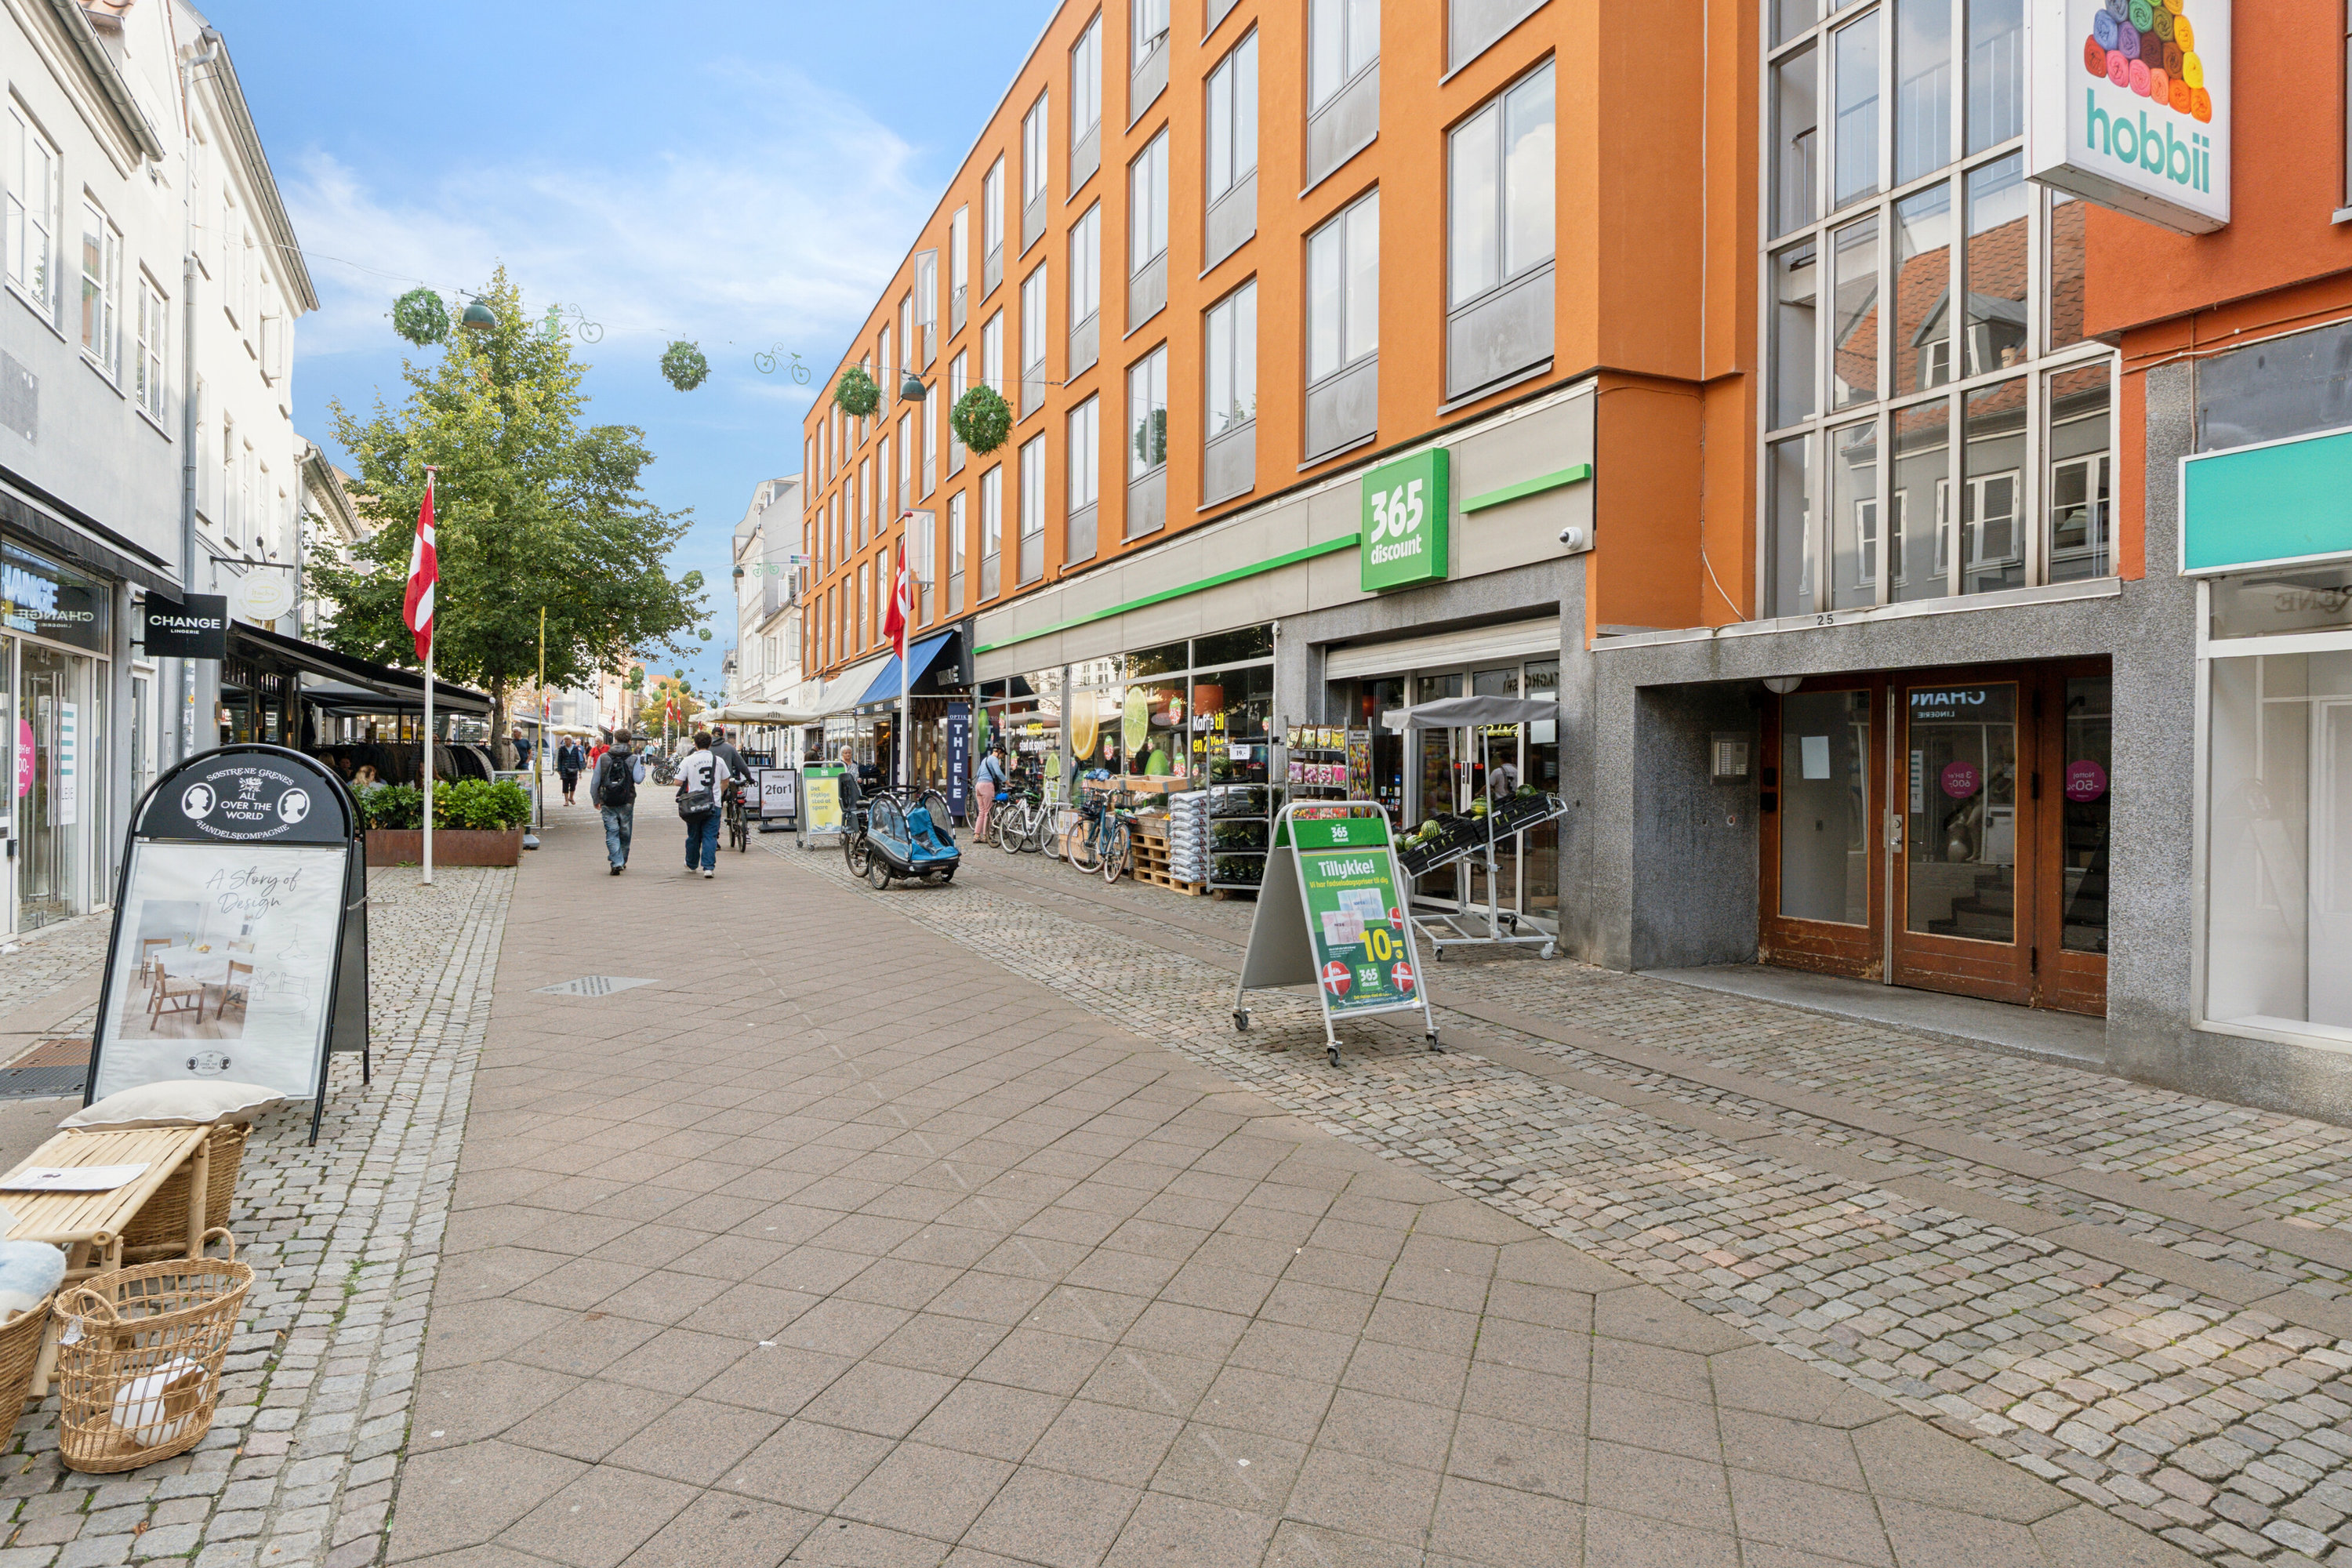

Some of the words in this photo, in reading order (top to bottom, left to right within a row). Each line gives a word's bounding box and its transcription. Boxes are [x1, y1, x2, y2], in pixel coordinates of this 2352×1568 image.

[2087, 87, 2209, 194] hobbii
[1371, 478, 1424, 544] 365
[1371, 534, 1422, 564] discount
[0, 561, 59, 616] HANGE
[149, 615, 221, 630] CHANGE
[1817, 614, 1834, 626] 25
[1214, 713, 1225, 730] til
[1192, 739, 1203, 753] en
[953, 724, 964, 799] THIELE
[206, 768, 256, 782] SØSTRENE
[258, 768, 295, 786] GRENES
[699, 766, 713, 787] 3
[238, 792, 256, 801] ALL
[764, 783, 793, 796] 2for1
[220, 800, 249, 810] OVER
[253, 802, 272, 811] THE
[226, 811, 264, 820] WORLD
[196, 819, 290, 840] HANDELSKOMPAGNIE
[1330, 826, 1348, 838] 365
[1318, 859, 1375, 880] Tillykke!
[205, 868, 225, 890] A
[229, 866, 278, 898] Story
[283, 867, 303, 892] of
[217, 892, 282, 920] Design
[1359, 967, 1378, 982] 365
